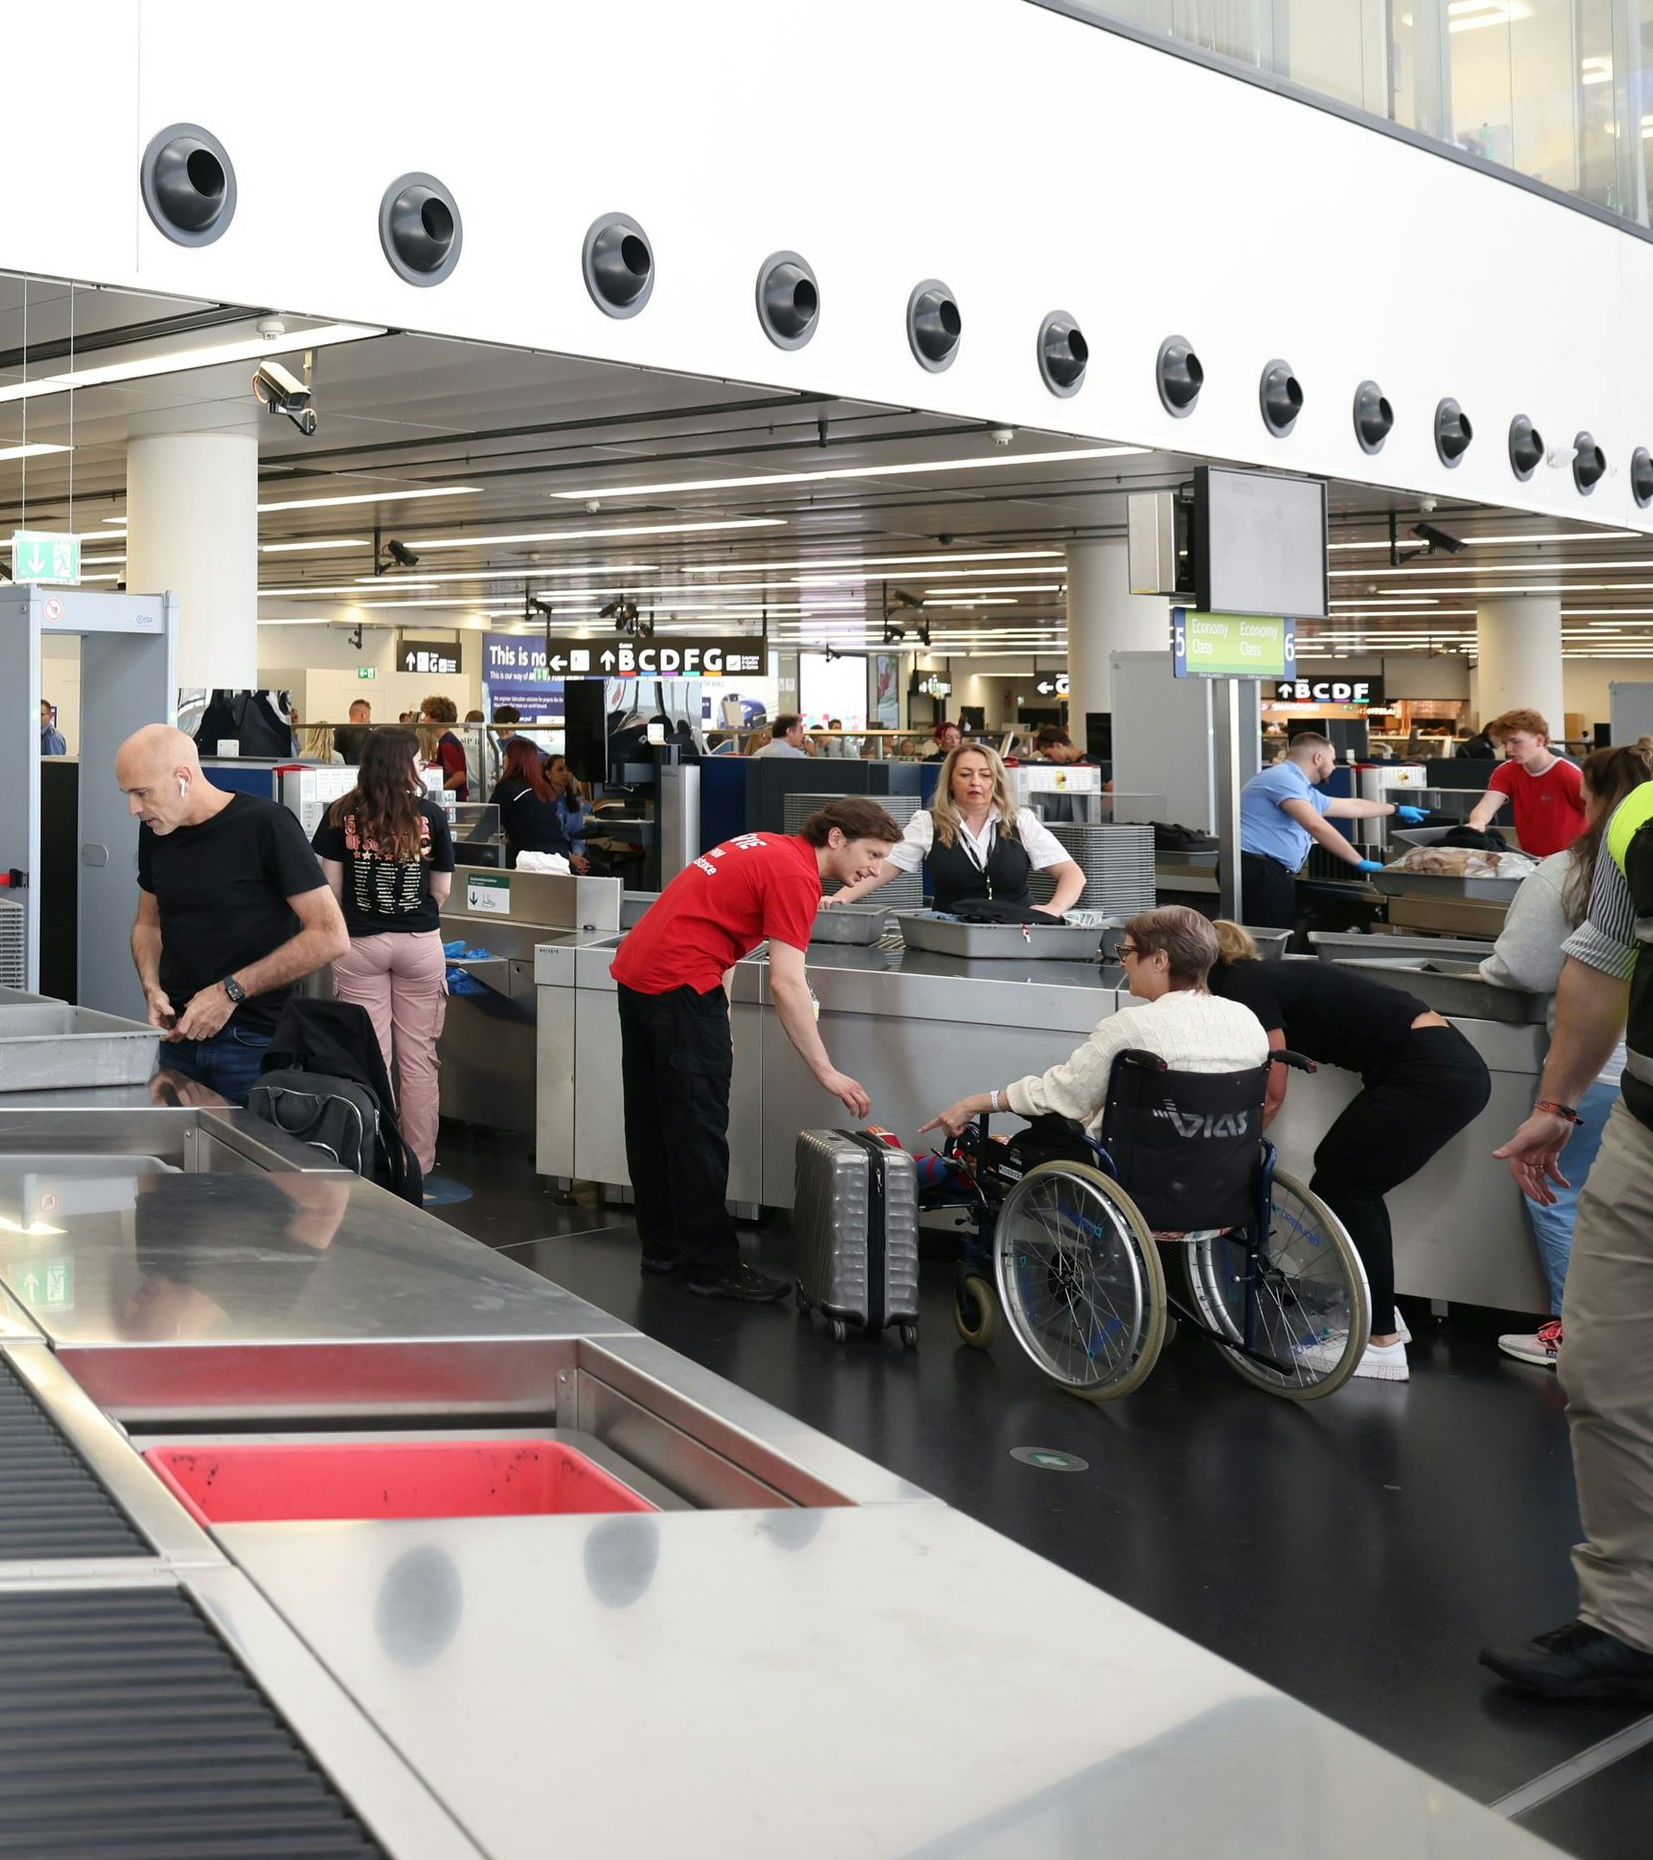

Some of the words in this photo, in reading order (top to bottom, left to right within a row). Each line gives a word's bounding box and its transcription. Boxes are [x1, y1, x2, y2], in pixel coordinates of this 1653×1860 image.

[1192, 618, 1228, 638] Economy
[1240, 622, 1278, 640] Economy
[1176, 627, 1185, 657] 5
[1192, 638, 1212, 654] Class
[1240, 642, 1262, 656] Class
[1284, 632, 1294, 662] 6
[490, 645, 516, 666] This
[519, 646, 528, 667] is
